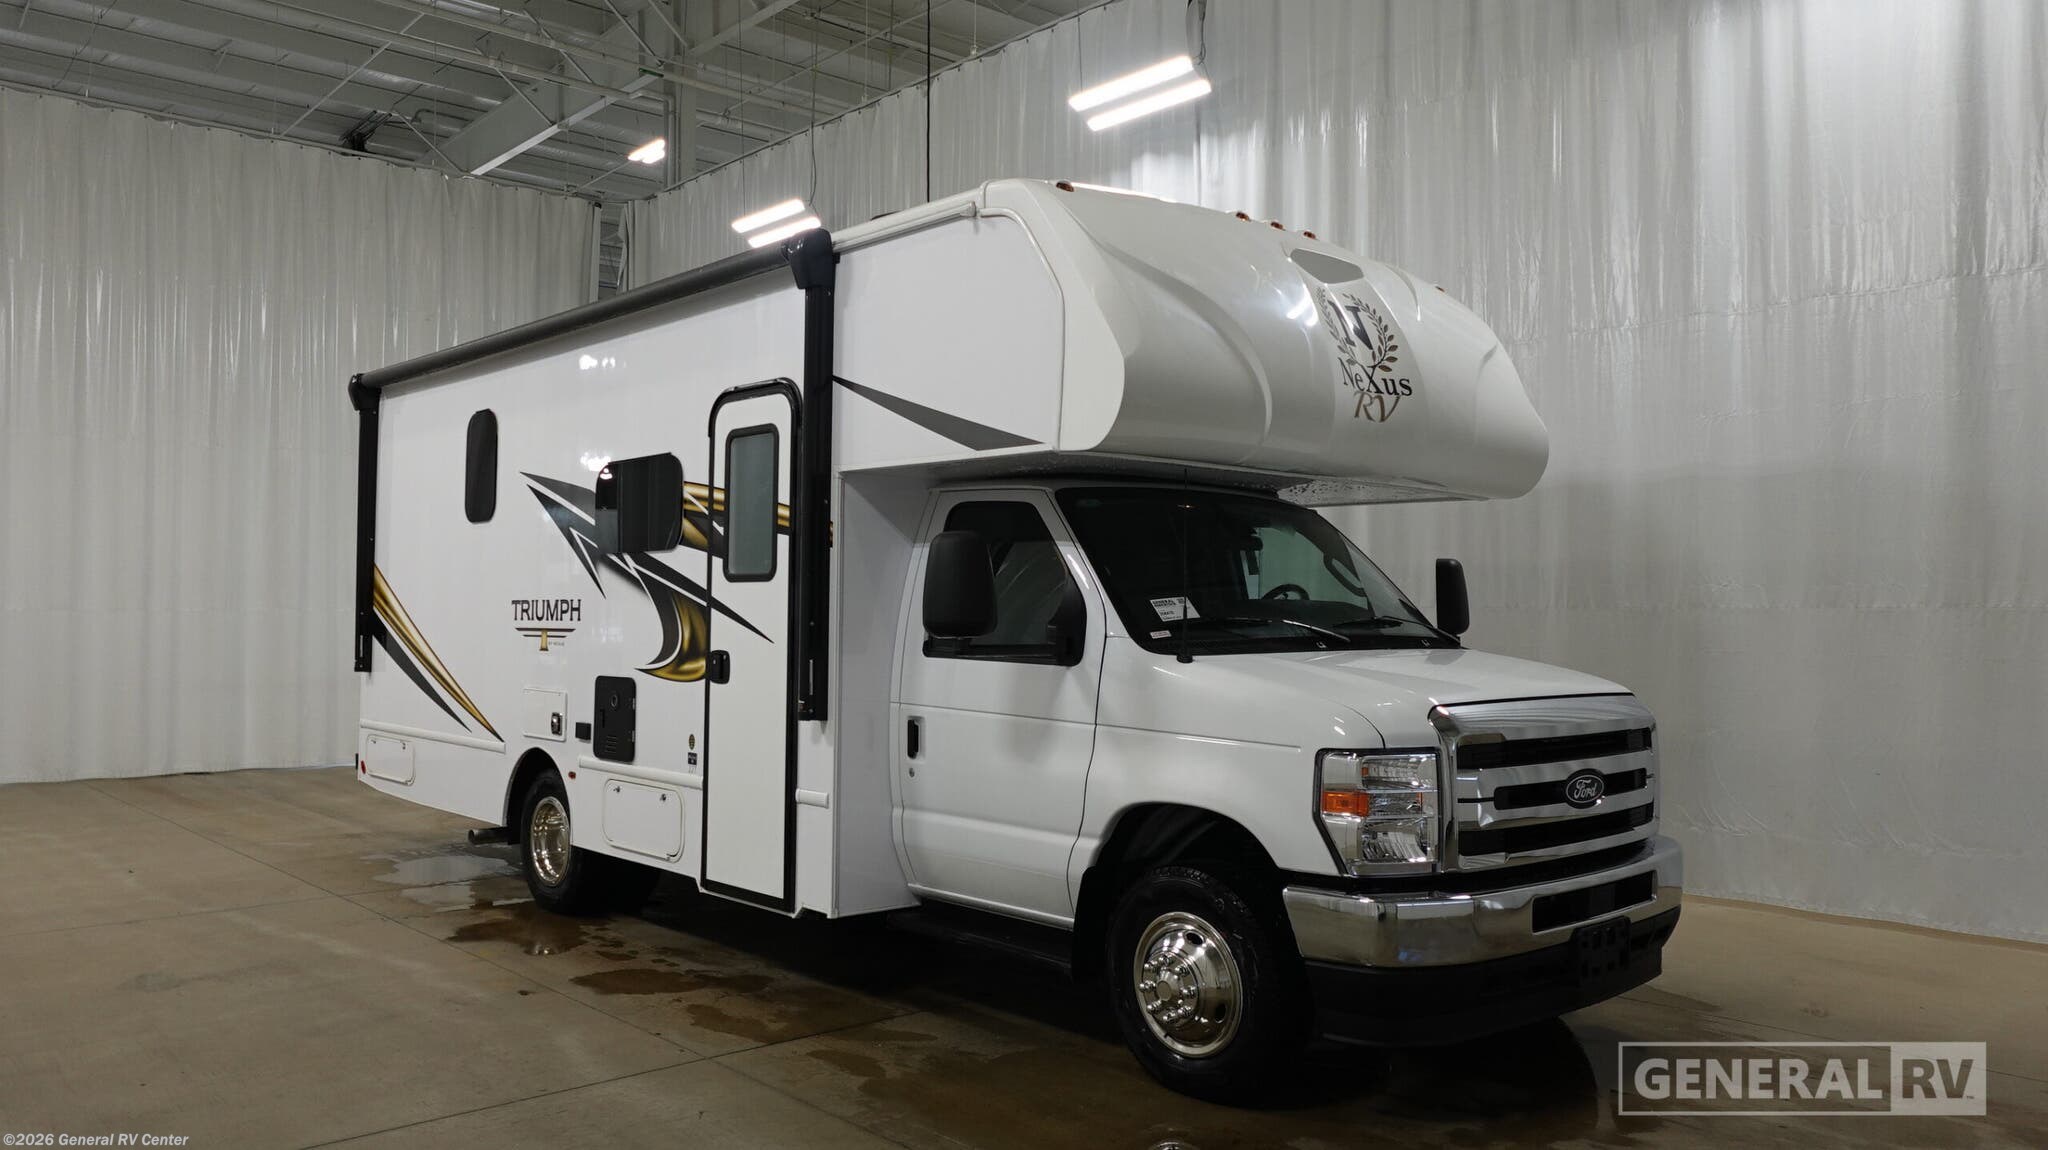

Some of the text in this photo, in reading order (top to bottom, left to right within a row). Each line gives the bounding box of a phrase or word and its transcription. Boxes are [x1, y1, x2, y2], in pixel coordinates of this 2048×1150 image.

[1353, 391, 1401, 423] RV
[511, 599, 582, 621] TRIUMPH
[1573, 779, 1598, 800] Ford
